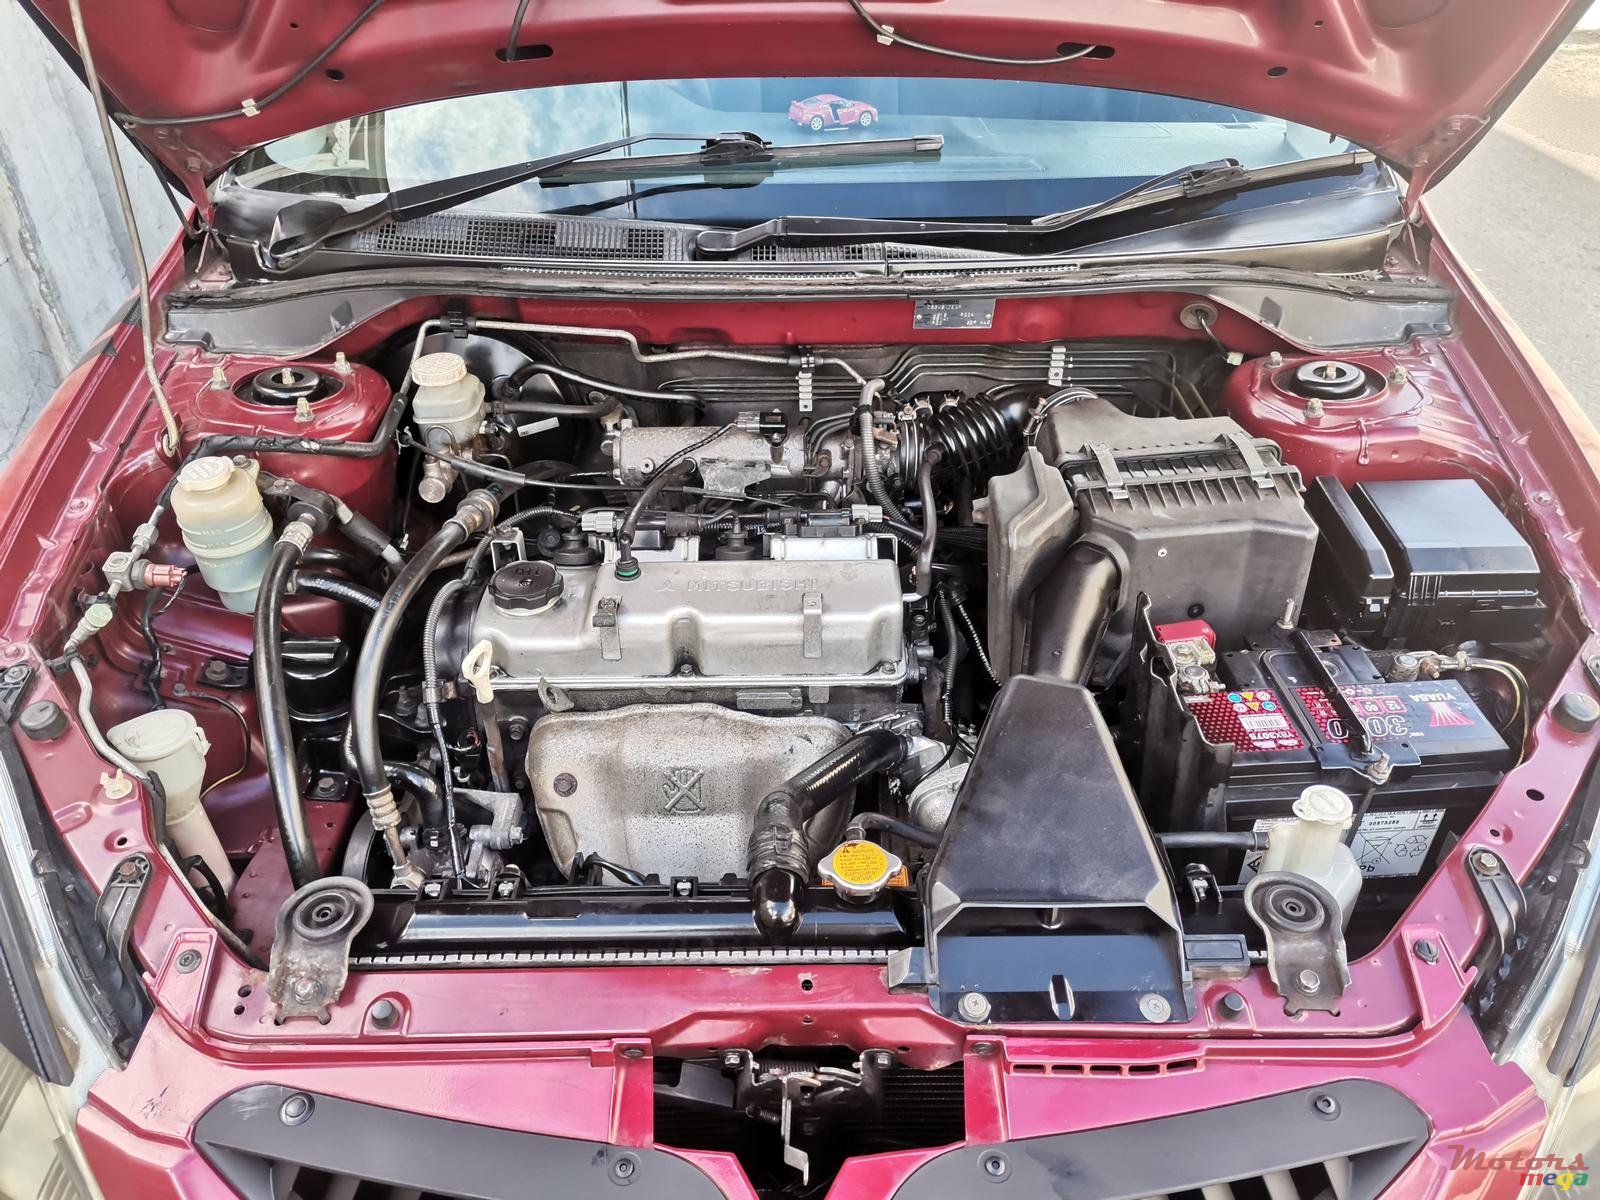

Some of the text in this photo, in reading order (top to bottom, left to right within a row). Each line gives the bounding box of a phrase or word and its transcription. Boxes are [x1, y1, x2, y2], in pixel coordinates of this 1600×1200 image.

[515, 567, 541, 577] OIL
[687, 578, 818, 592] MITSUBISHI
[1410, 693, 1456, 702] YUASA
[1327, 715, 1408, 739] 300
